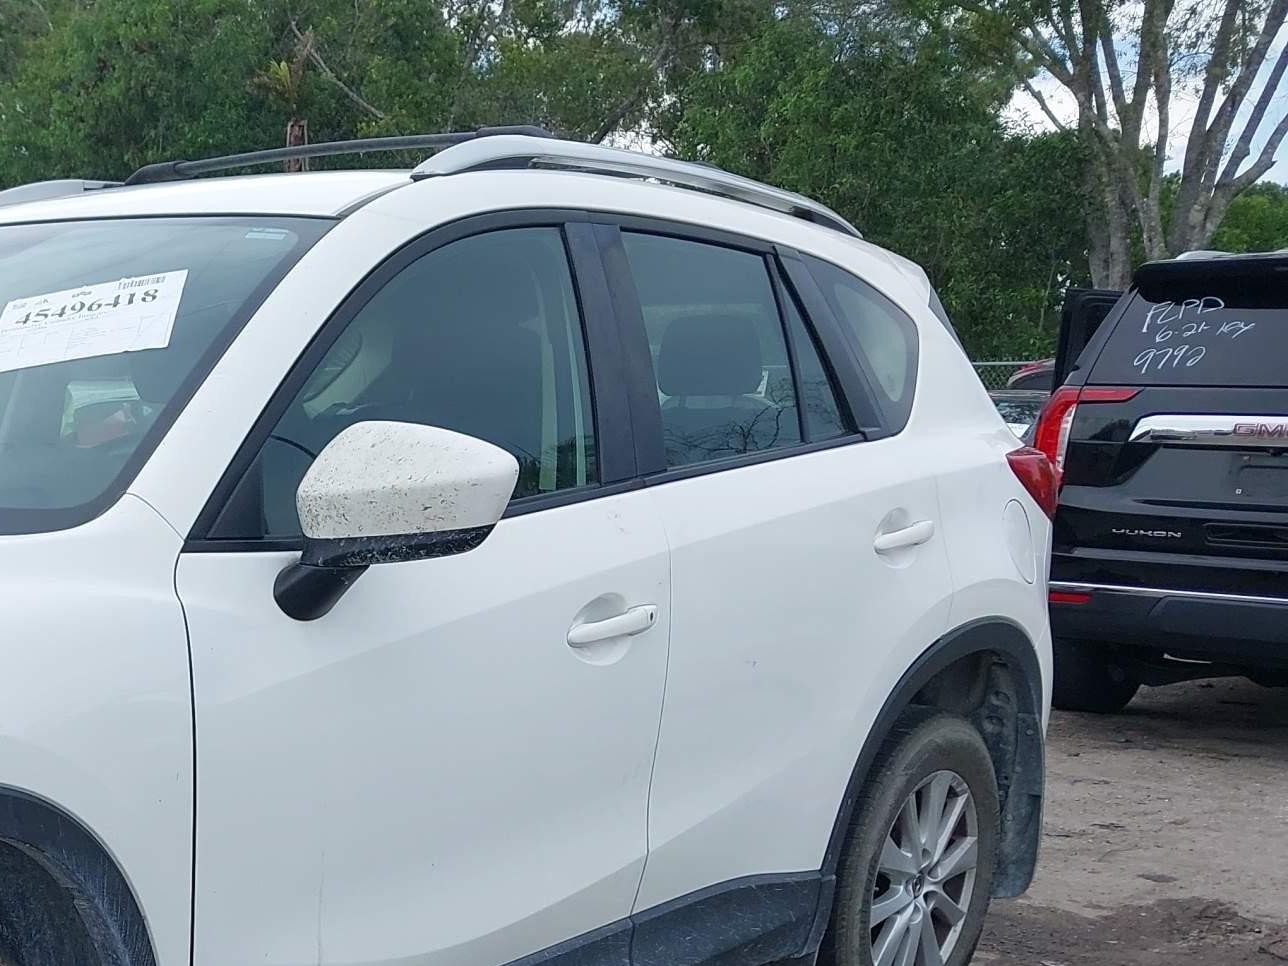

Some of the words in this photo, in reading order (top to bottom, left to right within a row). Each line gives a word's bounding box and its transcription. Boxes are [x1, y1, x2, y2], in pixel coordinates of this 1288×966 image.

[15, 289, 158, 325] 45496418
[1134, 345, 1205, 375] 9792
[1232, 423, 1288, 438] GM
[1112, 528, 1182, 538] YUKON
